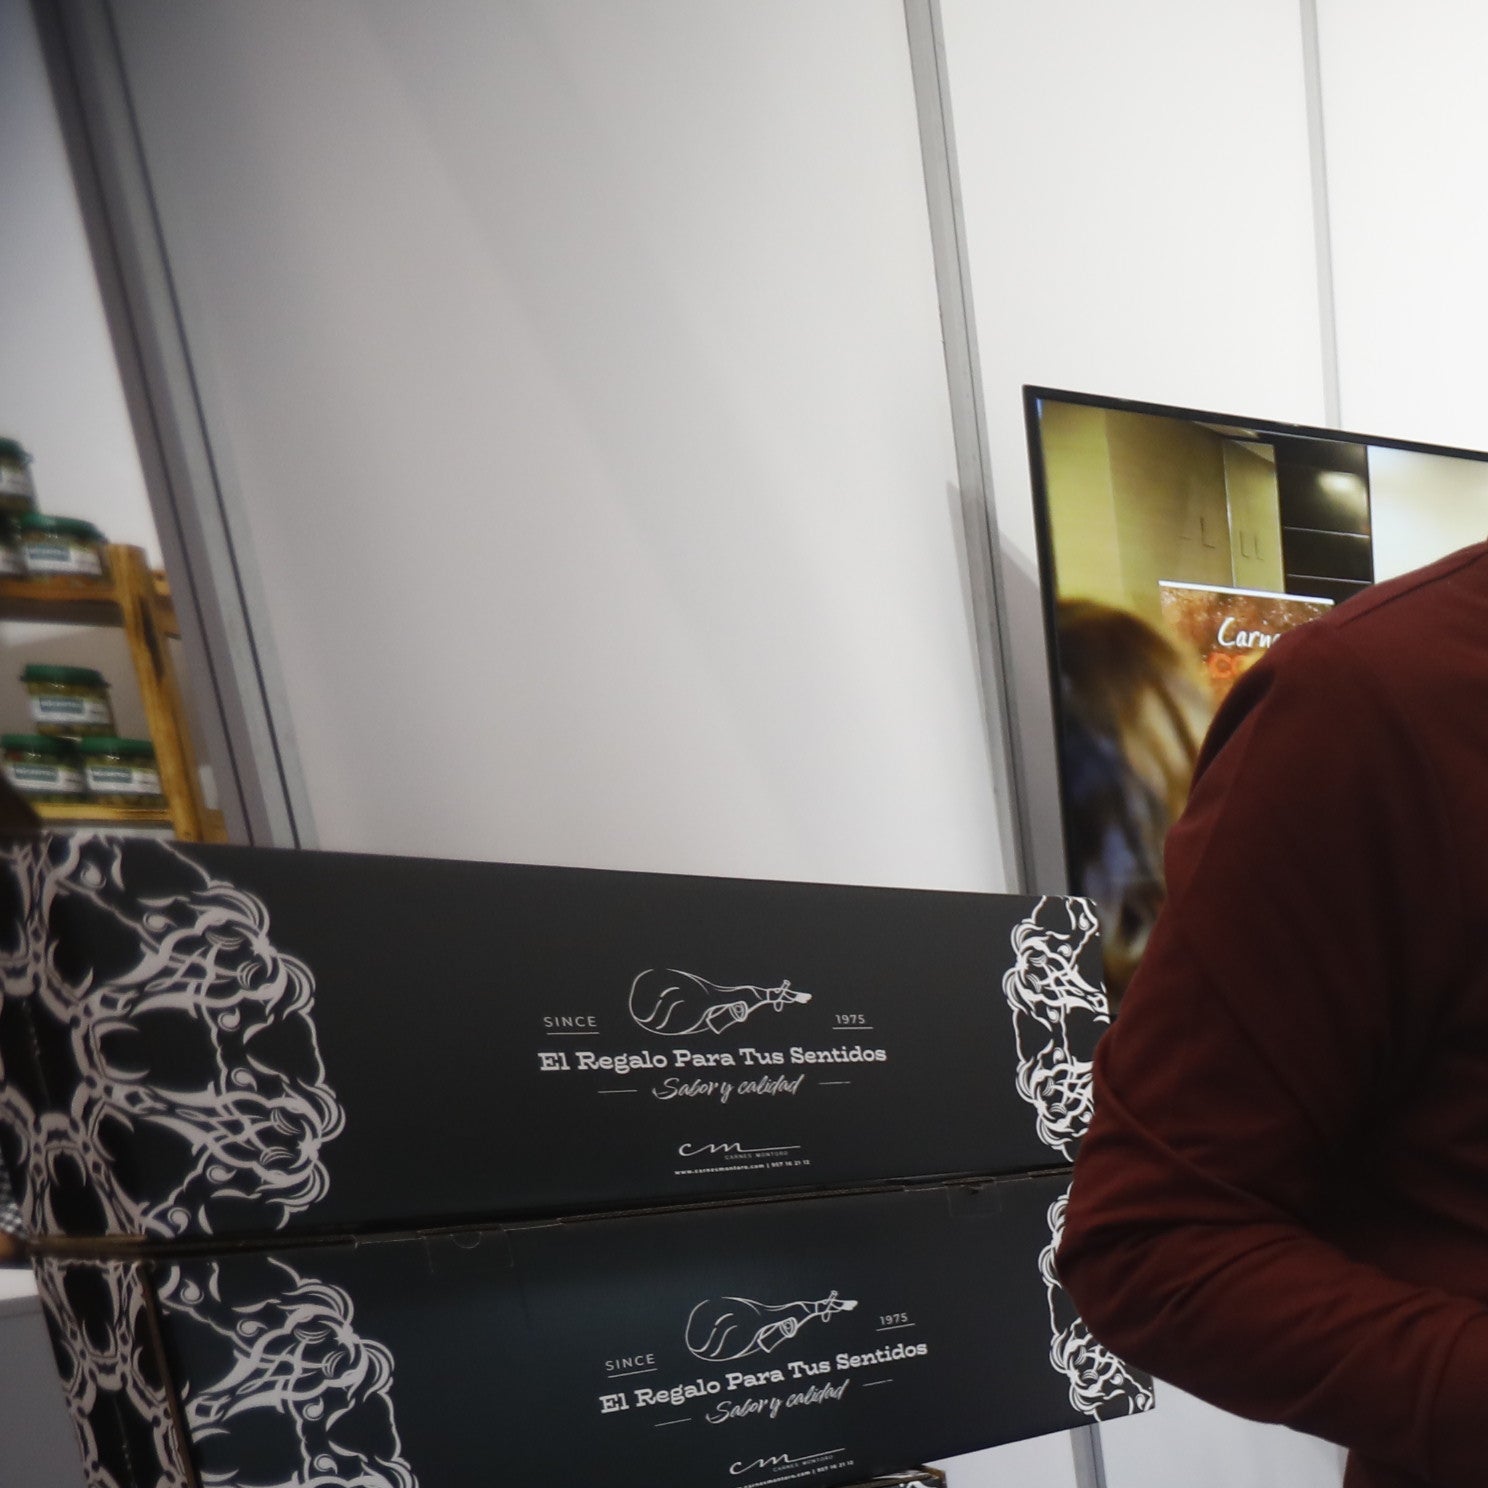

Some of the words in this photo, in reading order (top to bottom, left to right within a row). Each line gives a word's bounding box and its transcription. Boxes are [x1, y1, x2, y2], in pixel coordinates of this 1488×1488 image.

[544, 1016, 597, 1027] SINCE
[835, 1014, 866, 1025] 1975
[538, 1051, 570, 1071] El
[576, 1051, 668, 1075] Regalo
[673, 1049, 736, 1068] Para
[739, 1048, 784, 1066] Tus
[790, 1045, 888, 1064] Sentidos
[652, 1077, 719, 1101] Sabor
[716, 1083, 733, 1104] y
[737, 1074, 805, 1096] calidad
[880, 1312, 908, 1325] 1975
[605, 1353, 655, 1371] SINCE
[599, 1393, 628, 1414] El
[634, 1378, 720, 1407] Regalo
[726, 1369, 785, 1391] Para
[787, 1360, 831, 1379] Tus
[835, 1342, 928, 1370] Sentidos
[705, 1398, 768, 1424] Sabor
[768, 1397, 782, 1418] y
[785, 1378, 850, 1407] calidad
